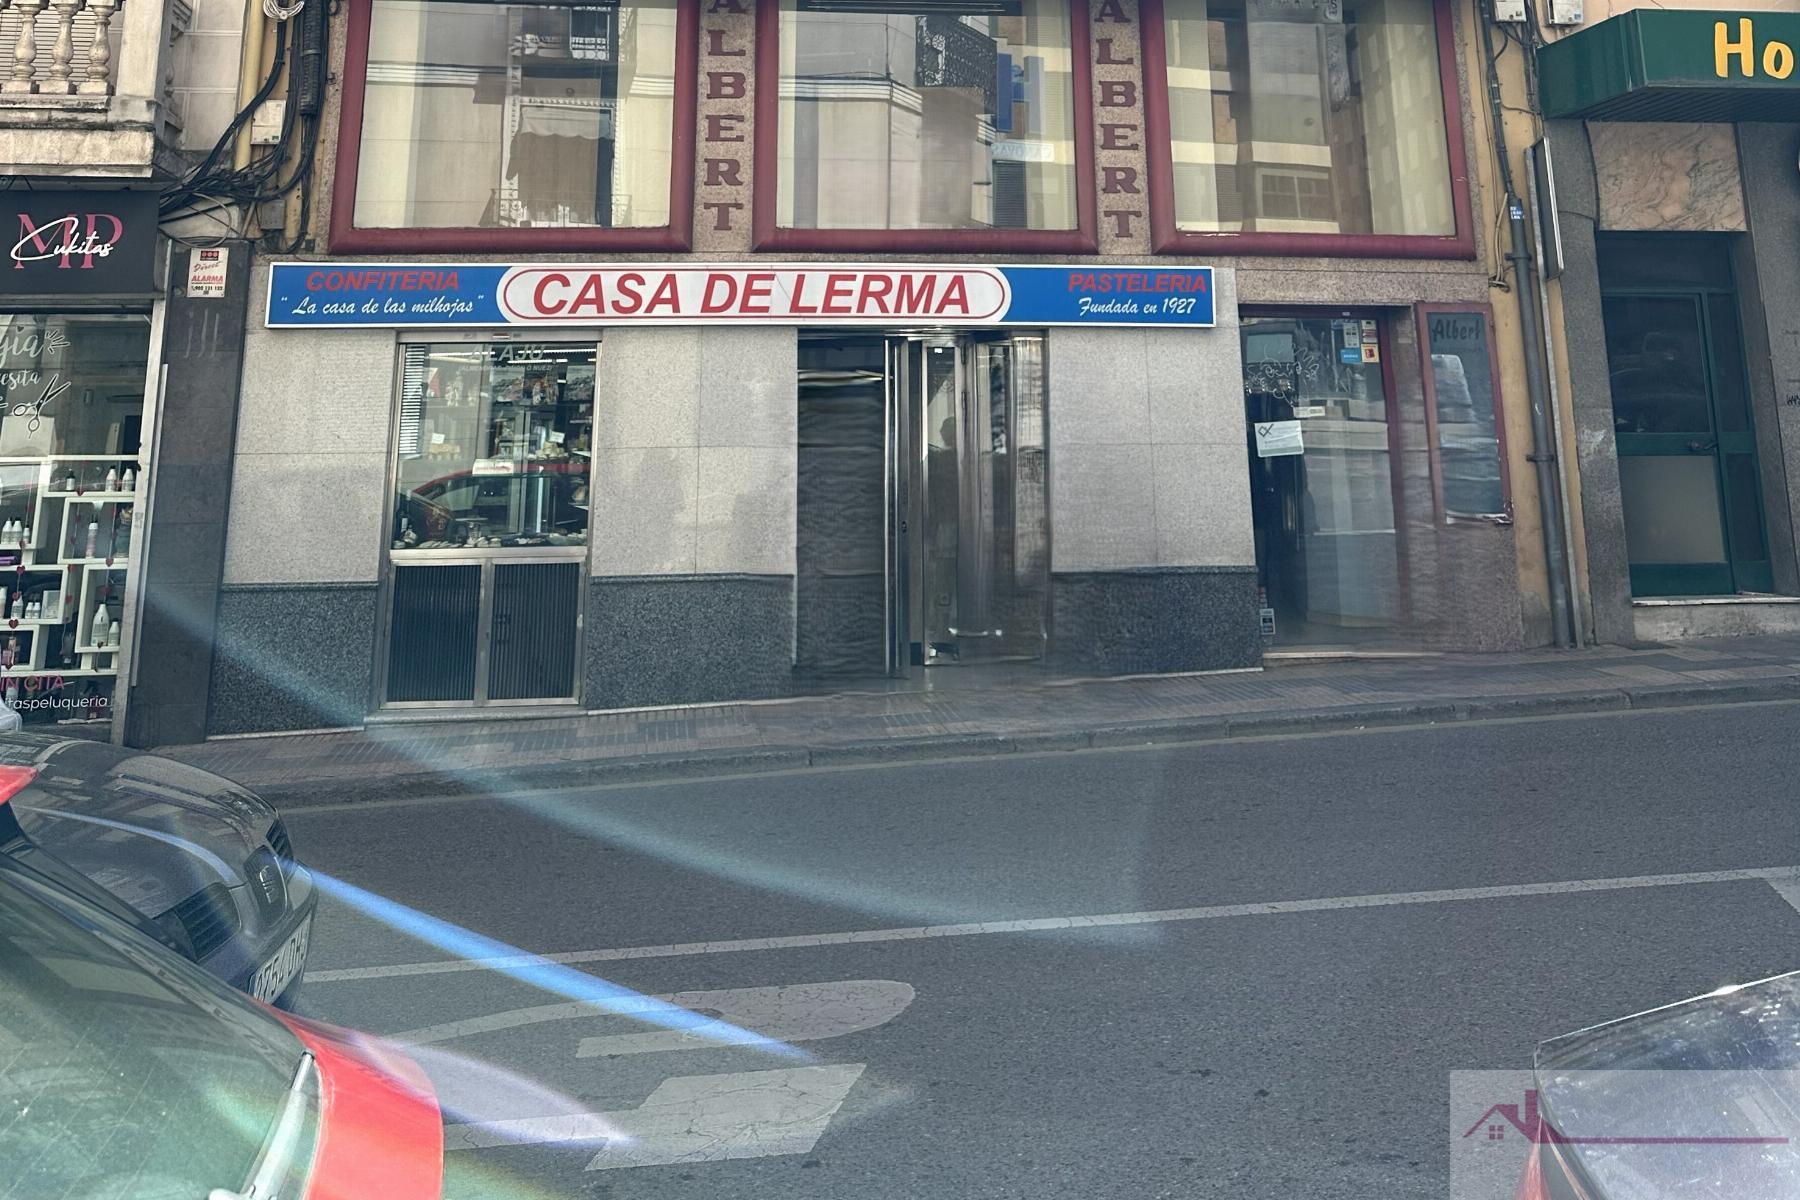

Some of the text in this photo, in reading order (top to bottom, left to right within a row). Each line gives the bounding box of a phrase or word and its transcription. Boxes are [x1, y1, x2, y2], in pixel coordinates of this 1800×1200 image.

[1714, 17, 1794, 80] Ho
[191, 275, 224, 283] ALARMA
[306, 271, 1207, 314] CONFITERIA CASA DE LERMA PASTELERIA
[322, 302, 356, 314] casa
[361, 298, 379, 313] de
[384, 298, 406, 313] las
[1078, 297, 1196, 316] Fundada en 1927
[1432, 318, 1481, 343] Albert
[24, 675, 64, 691] CITA
